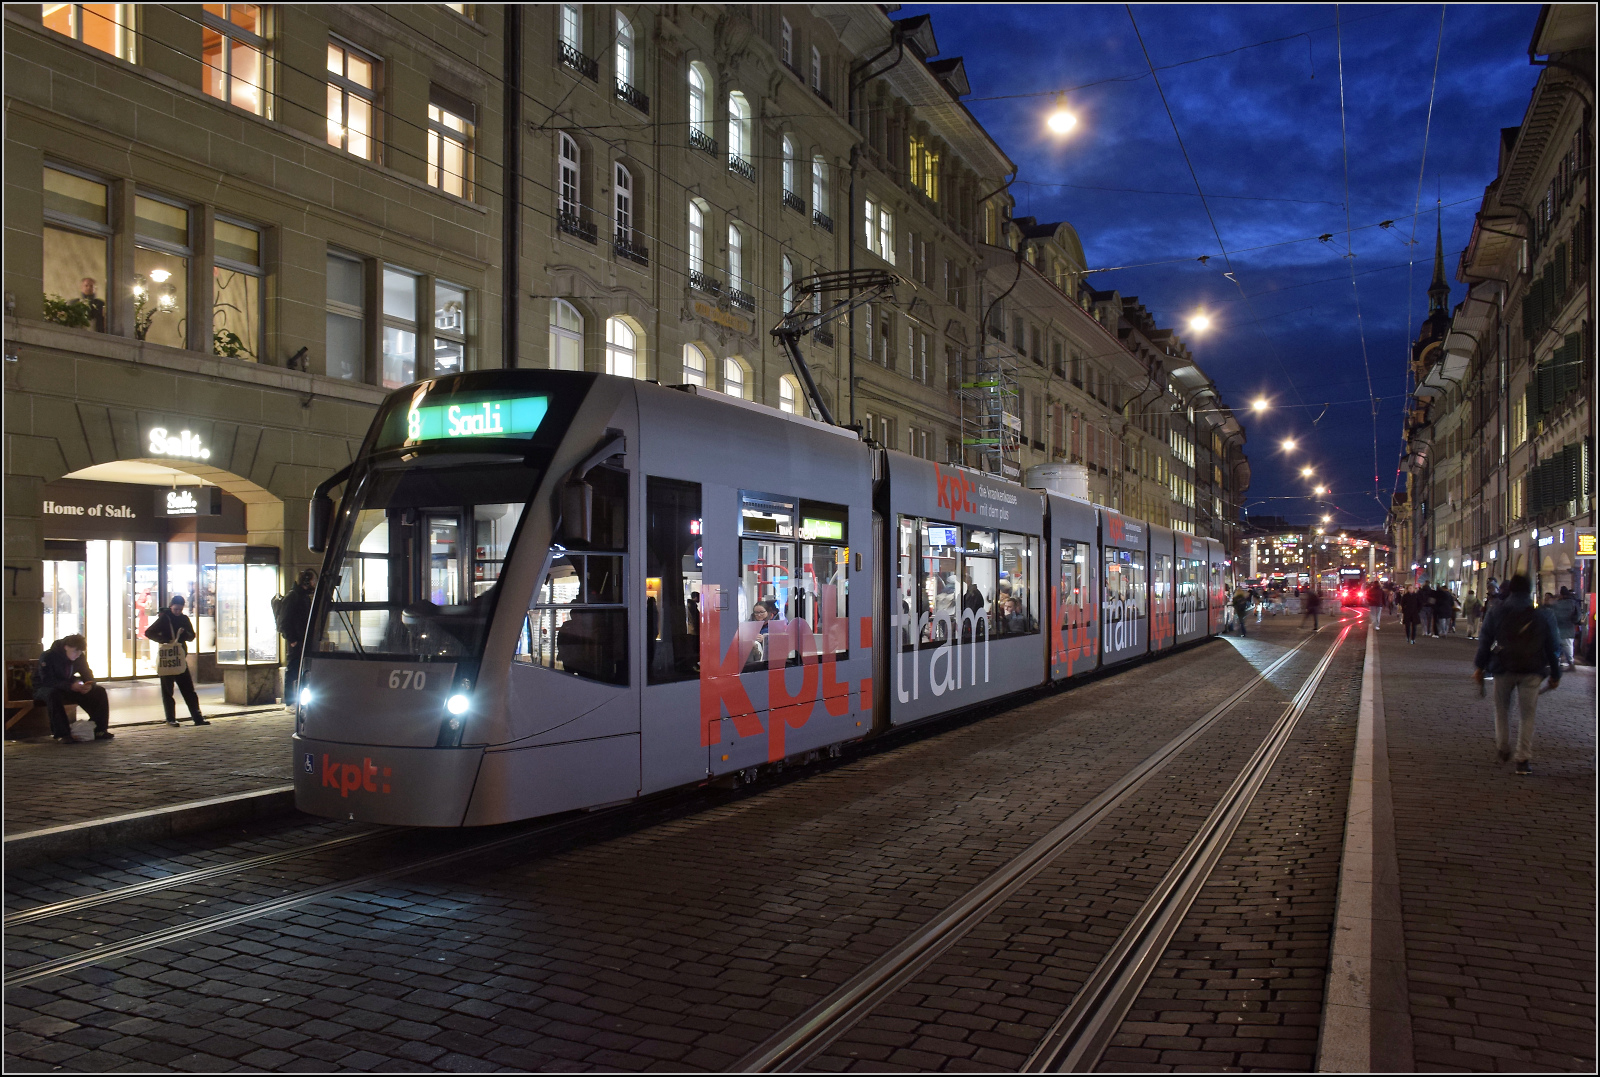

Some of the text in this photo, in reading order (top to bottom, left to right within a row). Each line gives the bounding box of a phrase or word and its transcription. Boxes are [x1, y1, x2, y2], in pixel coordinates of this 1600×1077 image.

[408, 403, 503, 439] 8 Saali
[149, 428, 211, 459] Salt.
[43, 501, 136, 519] Home of Salt.
[934, 462, 977, 521] kpt:
[979, 484, 988, 498] die
[989, 504, 998, 518] dem
[1000, 507, 1009, 522] plus
[1051, 586, 1097, 677] kpt:
[1102, 587, 1138, 653] tram
[1176, 587, 1197, 636] tram
[891, 587, 990, 703] tram
[389, 670, 426, 690] 670
[700, 584, 872, 763] kpt:
[322, 754, 392, 798] kpt:
